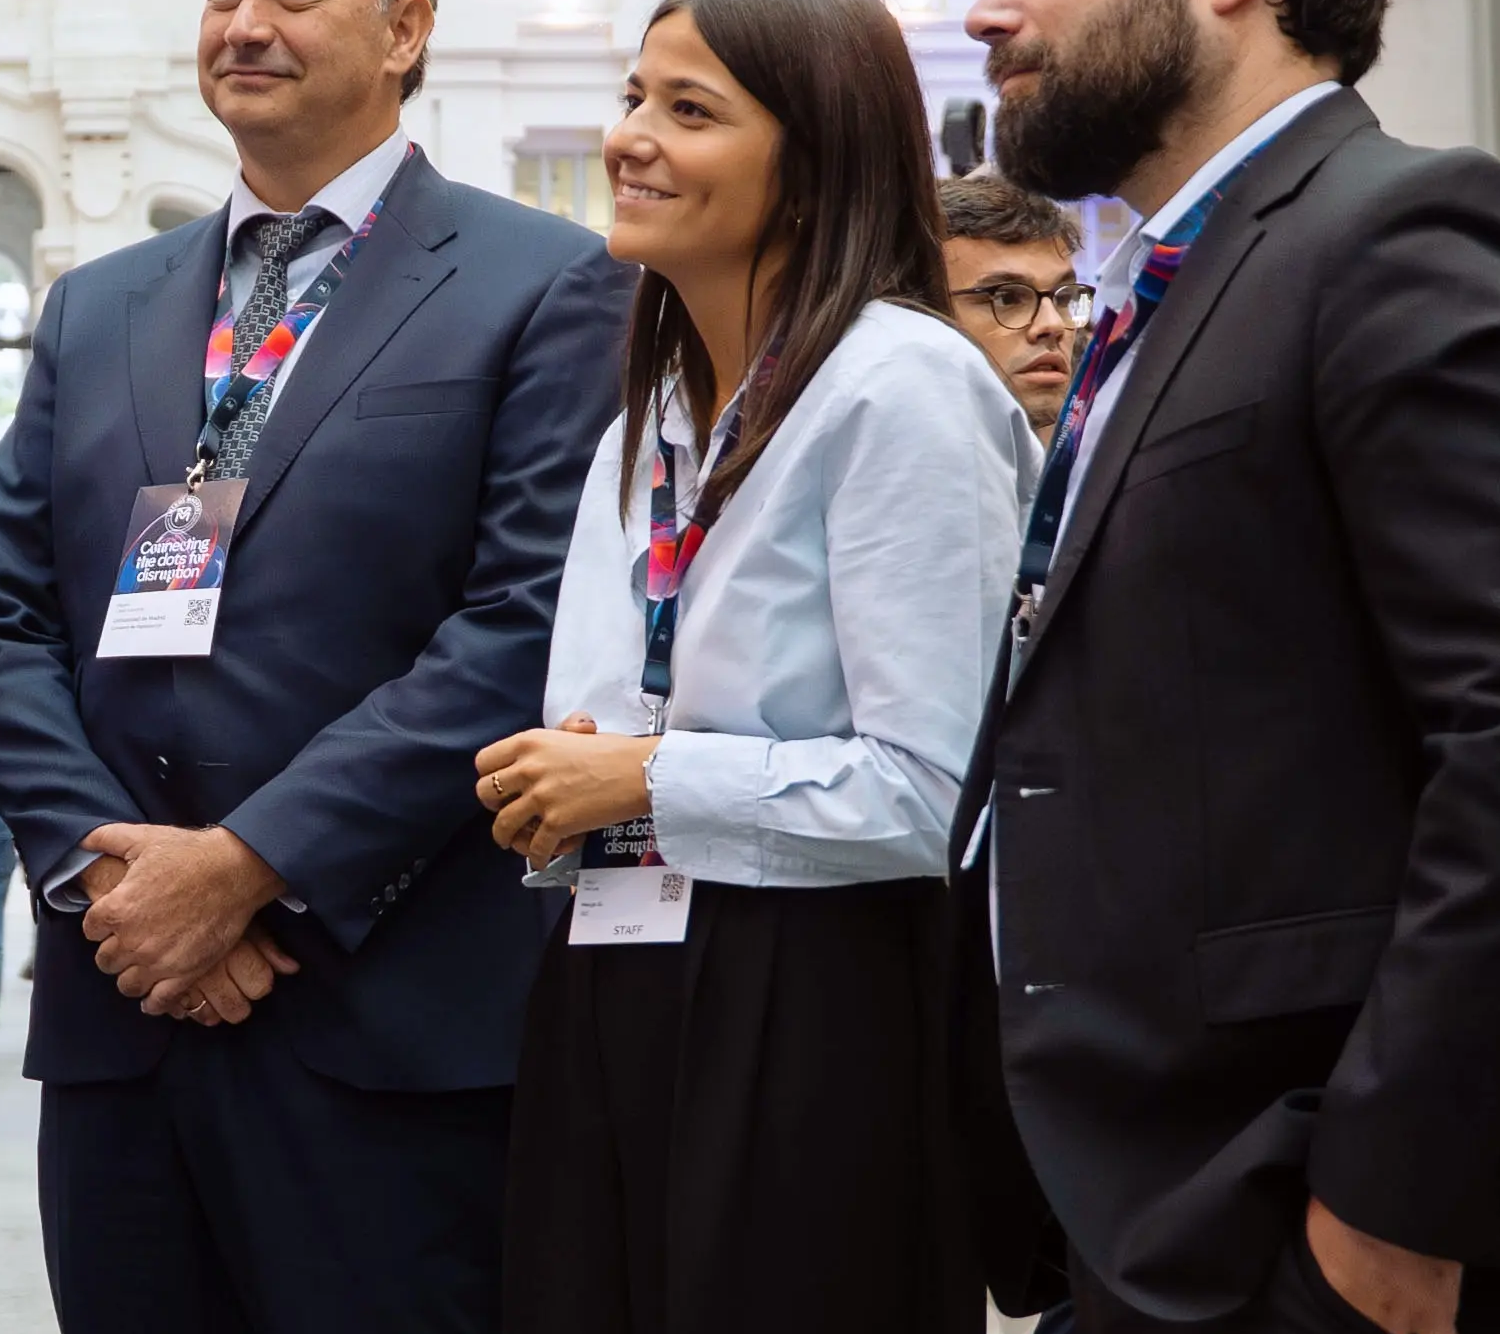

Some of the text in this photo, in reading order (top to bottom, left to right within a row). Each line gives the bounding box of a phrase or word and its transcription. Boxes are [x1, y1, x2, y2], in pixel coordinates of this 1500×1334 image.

[140, 537, 211, 556] Connecting
[136, 552, 210, 569] the dots for
[136, 566, 200, 584] disruption
[613, 925, 644, 936] STAFF
